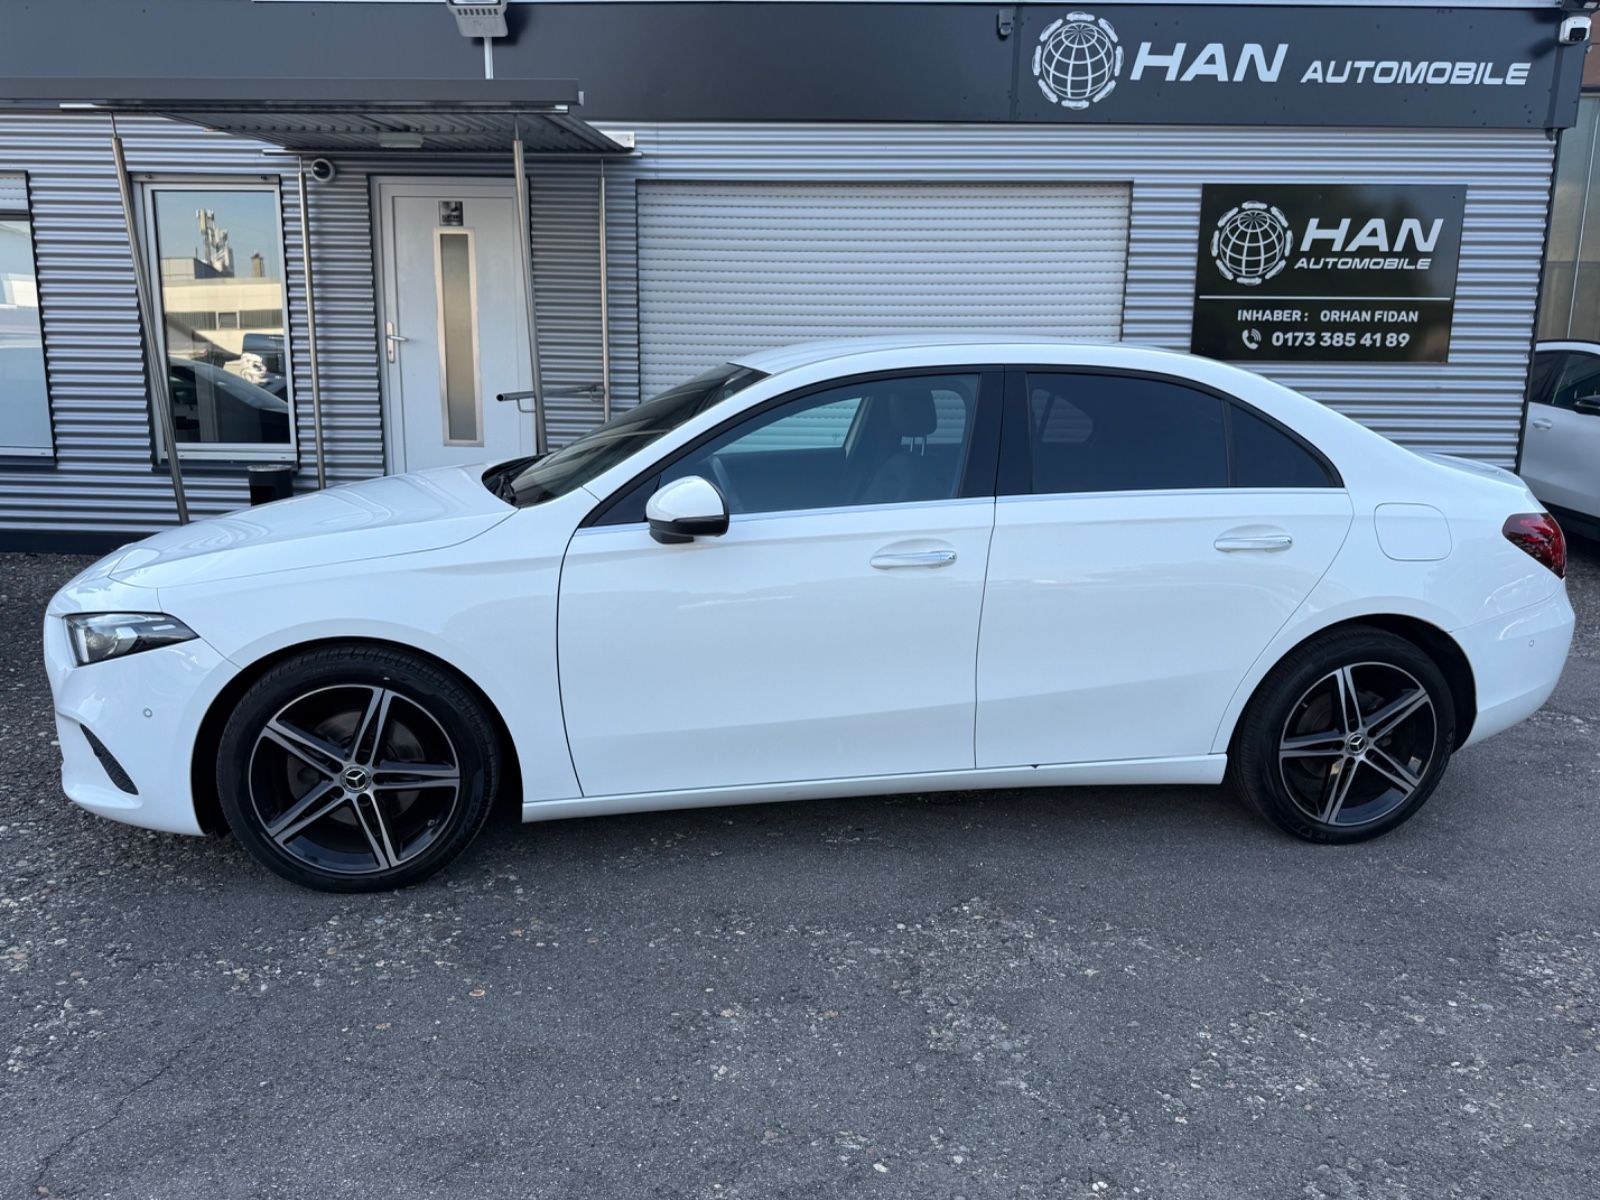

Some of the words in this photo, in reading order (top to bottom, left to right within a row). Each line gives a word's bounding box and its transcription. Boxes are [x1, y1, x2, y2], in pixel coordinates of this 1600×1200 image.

[1130, 42, 1289, 83] HAN
[1301, 60, 1532, 85] AUTOMOBILE
[1300, 218, 1444, 252] HAN
[1294, 257, 1432, 270] AUTOMOBILE
[1320, 310, 1371, 322] ORHAN
[1374, 310, 1419, 323] FIDAN
[1271, 331, 1316, 347] 0173
[1319, 332, 1356, 347] 385
